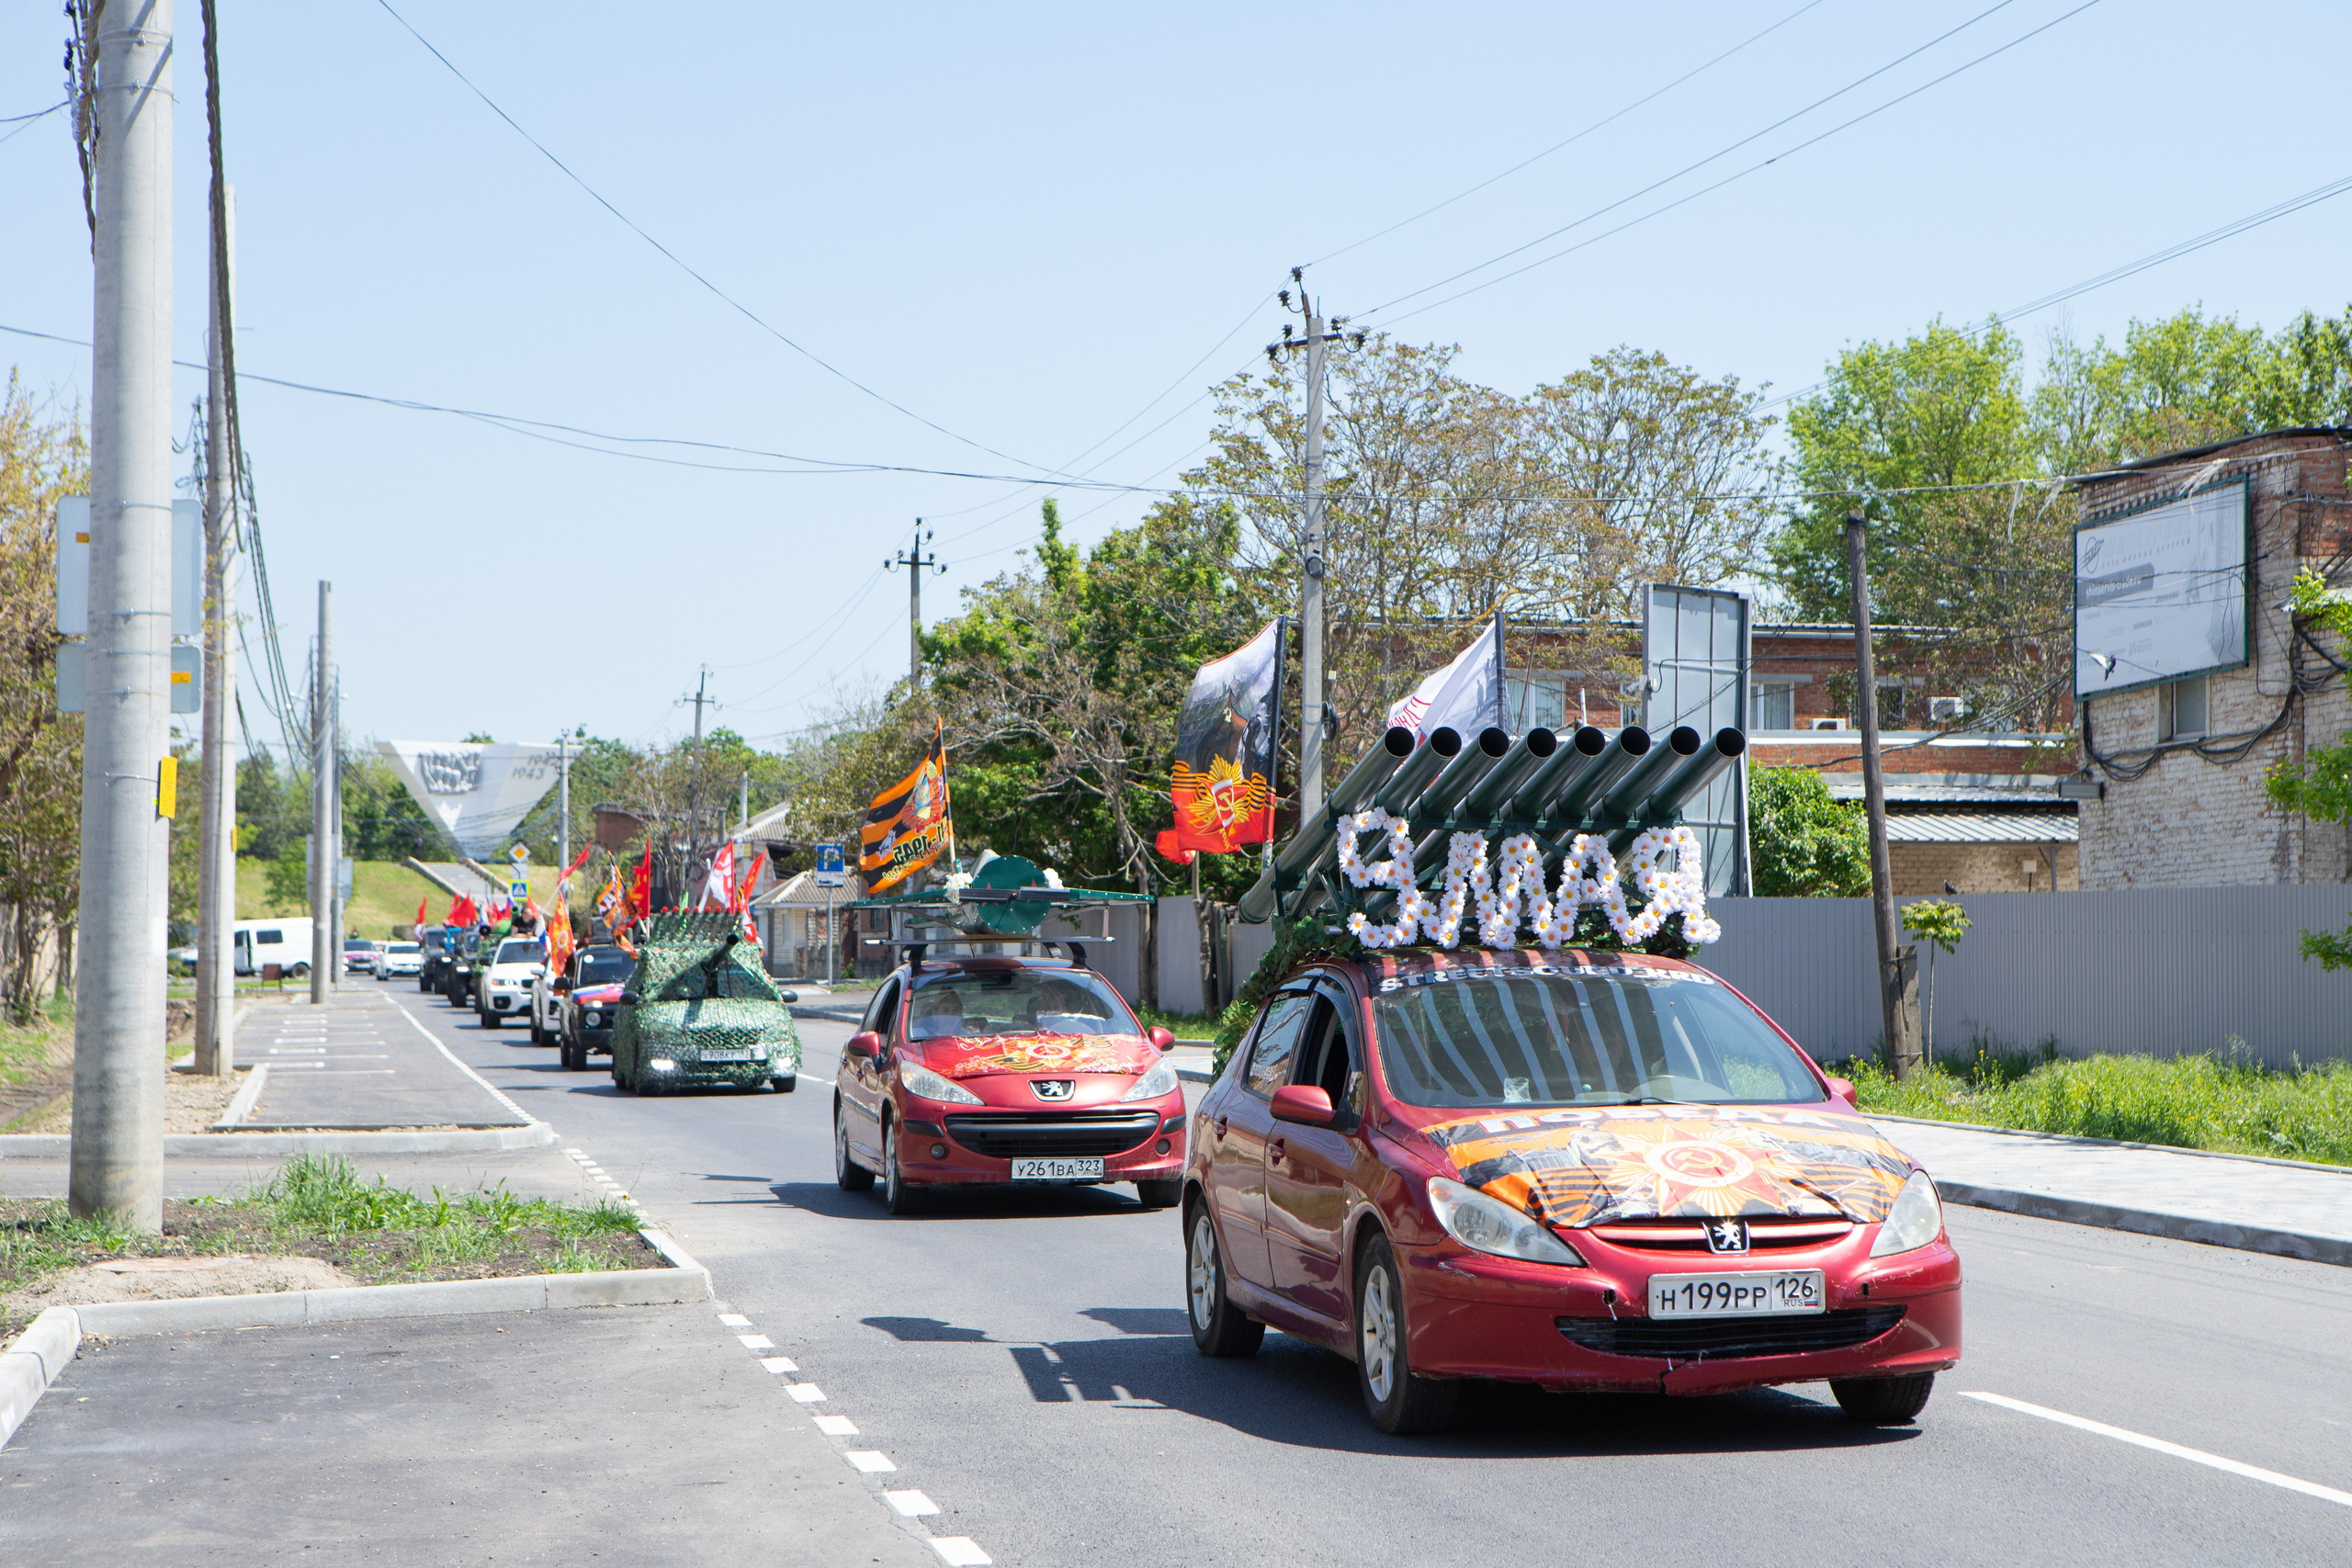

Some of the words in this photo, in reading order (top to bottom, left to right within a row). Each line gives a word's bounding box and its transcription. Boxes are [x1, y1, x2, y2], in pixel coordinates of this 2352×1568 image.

[512, 766, 545, 780] 1943
[823, 847, 840, 870] P
[1478, 1106, 1838, 1134] ПОБЕДА
[1018, 1161, 1075, 1176] У261ВА
[1078, 1160, 1100, 1171] 323
[1661, 1281, 1767, 1311] Н199РР
[1775, 1277, 1814, 1299] 126
[1783, 1299, 1803, 1307] RUS
